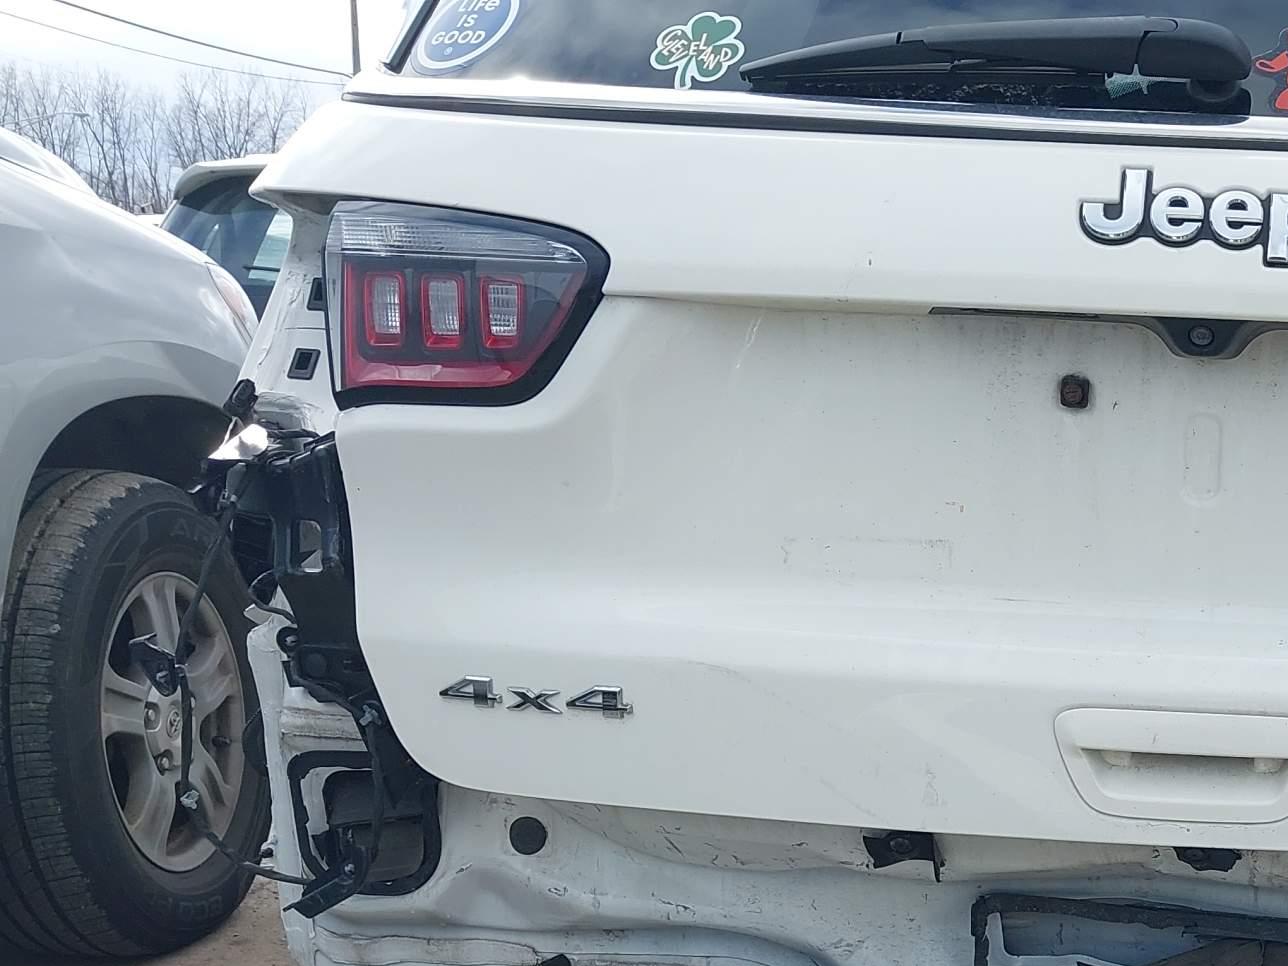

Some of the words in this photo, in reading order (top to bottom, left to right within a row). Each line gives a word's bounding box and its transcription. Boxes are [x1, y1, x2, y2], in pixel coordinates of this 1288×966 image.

[456, 14, 478, 28] IS
[431, 30, 486, 45] GOOD
[661, 29, 732, 71] CLEVELAND
